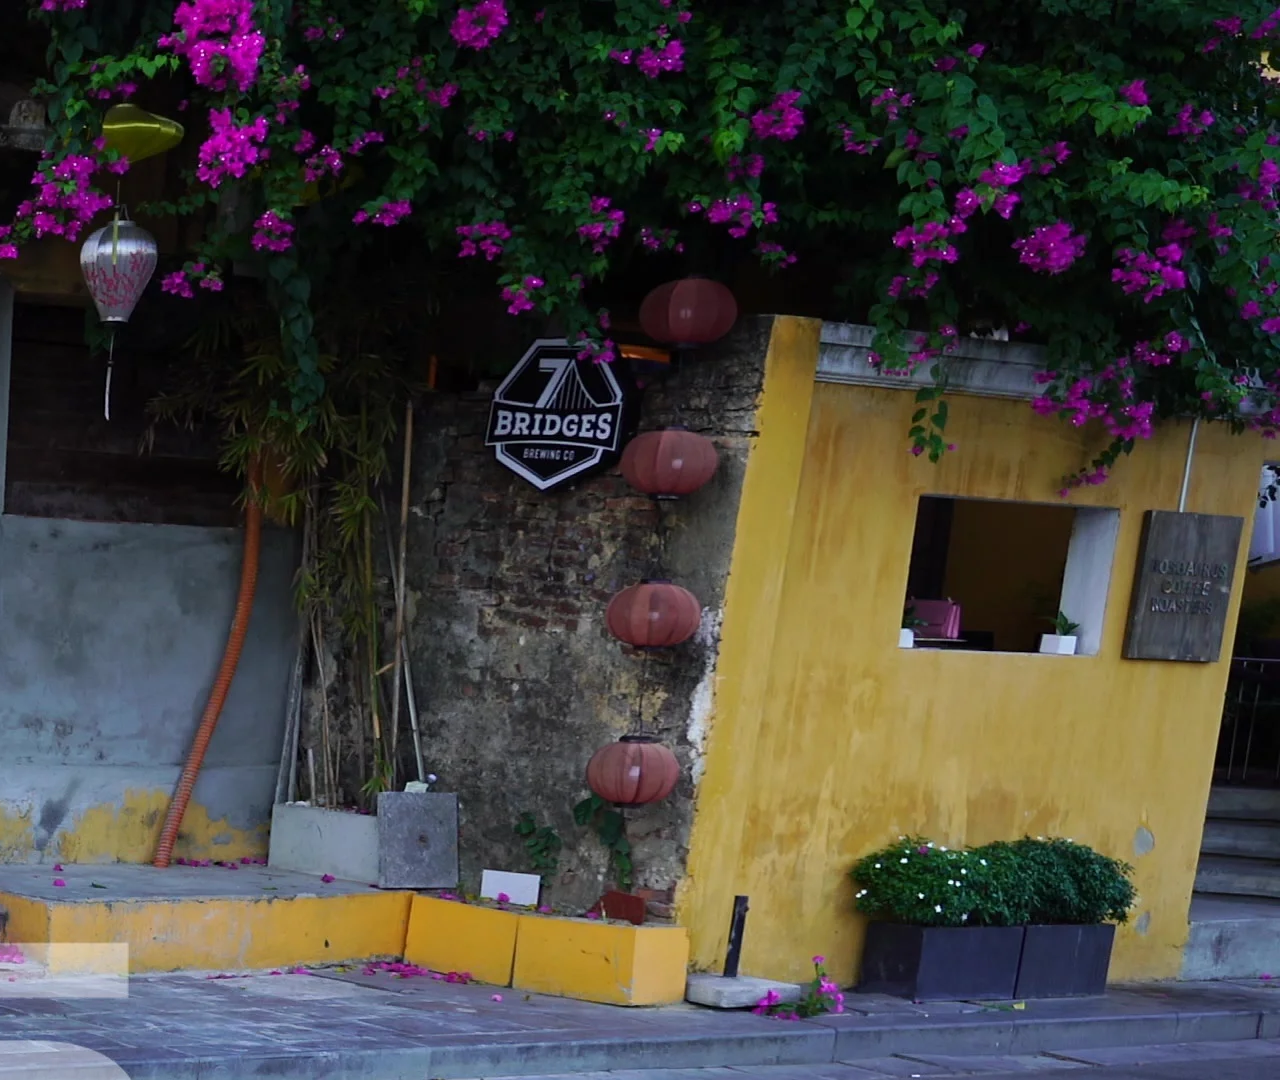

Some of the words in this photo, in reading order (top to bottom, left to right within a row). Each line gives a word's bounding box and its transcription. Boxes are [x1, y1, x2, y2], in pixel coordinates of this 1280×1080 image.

[535, 357, 572, 409] 7
[494, 409, 613, 440] BRIDGES
[522, 448, 561, 460] BREWING
